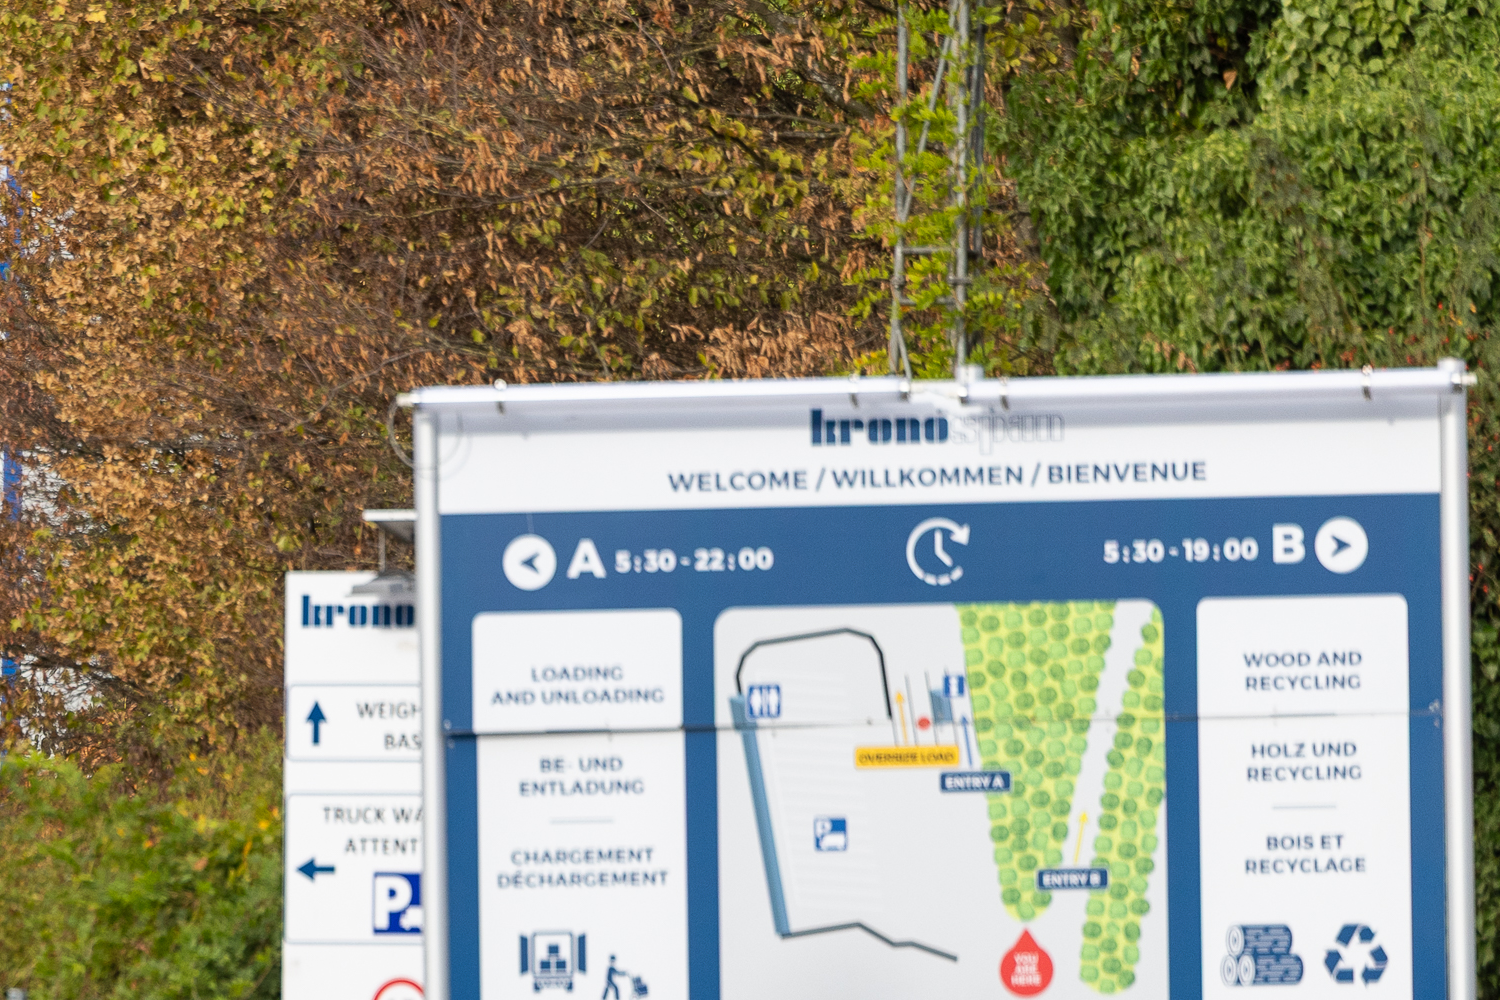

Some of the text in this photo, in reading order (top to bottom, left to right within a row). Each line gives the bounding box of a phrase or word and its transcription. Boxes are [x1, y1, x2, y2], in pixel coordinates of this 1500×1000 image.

[668, 470, 808, 493] WELCOME
[832, 465, 1023, 489] WILLKOMMEN
[1049, 461, 1207, 485] BIENVENUE
[1273, 524, 1305, 564] B
[567, 538, 606, 579] A
[1243, 650, 1362, 668] WOOD AND
[531, 666, 624, 682] LOADING
[1245, 674, 1362, 692] RECYCLING
[491, 688, 665, 706] AND UNLOADING
[922, 751, 954, 763] LOAD
[1251, 741, 1357, 759] HOLZ UND
[579, 757, 624, 772] UND
[1247, 764, 1362, 783] RECYCLING
[519, 780, 645, 797] ENTLADUNG
[945, 776, 1005, 789] ENTRY A
[324, 806, 385, 823] TRUCK
[345, 838, 417, 855] ATTENT
[1266, 834, 1344, 851] BOIS ET
[511, 847, 654, 866] CHARGEMENT
[1245, 857, 1367, 875] RECYCLAGE
[497, 870, 668, 889] DÉCHARGEMENT
[1042, 873, 1088, 886] ENTRY
